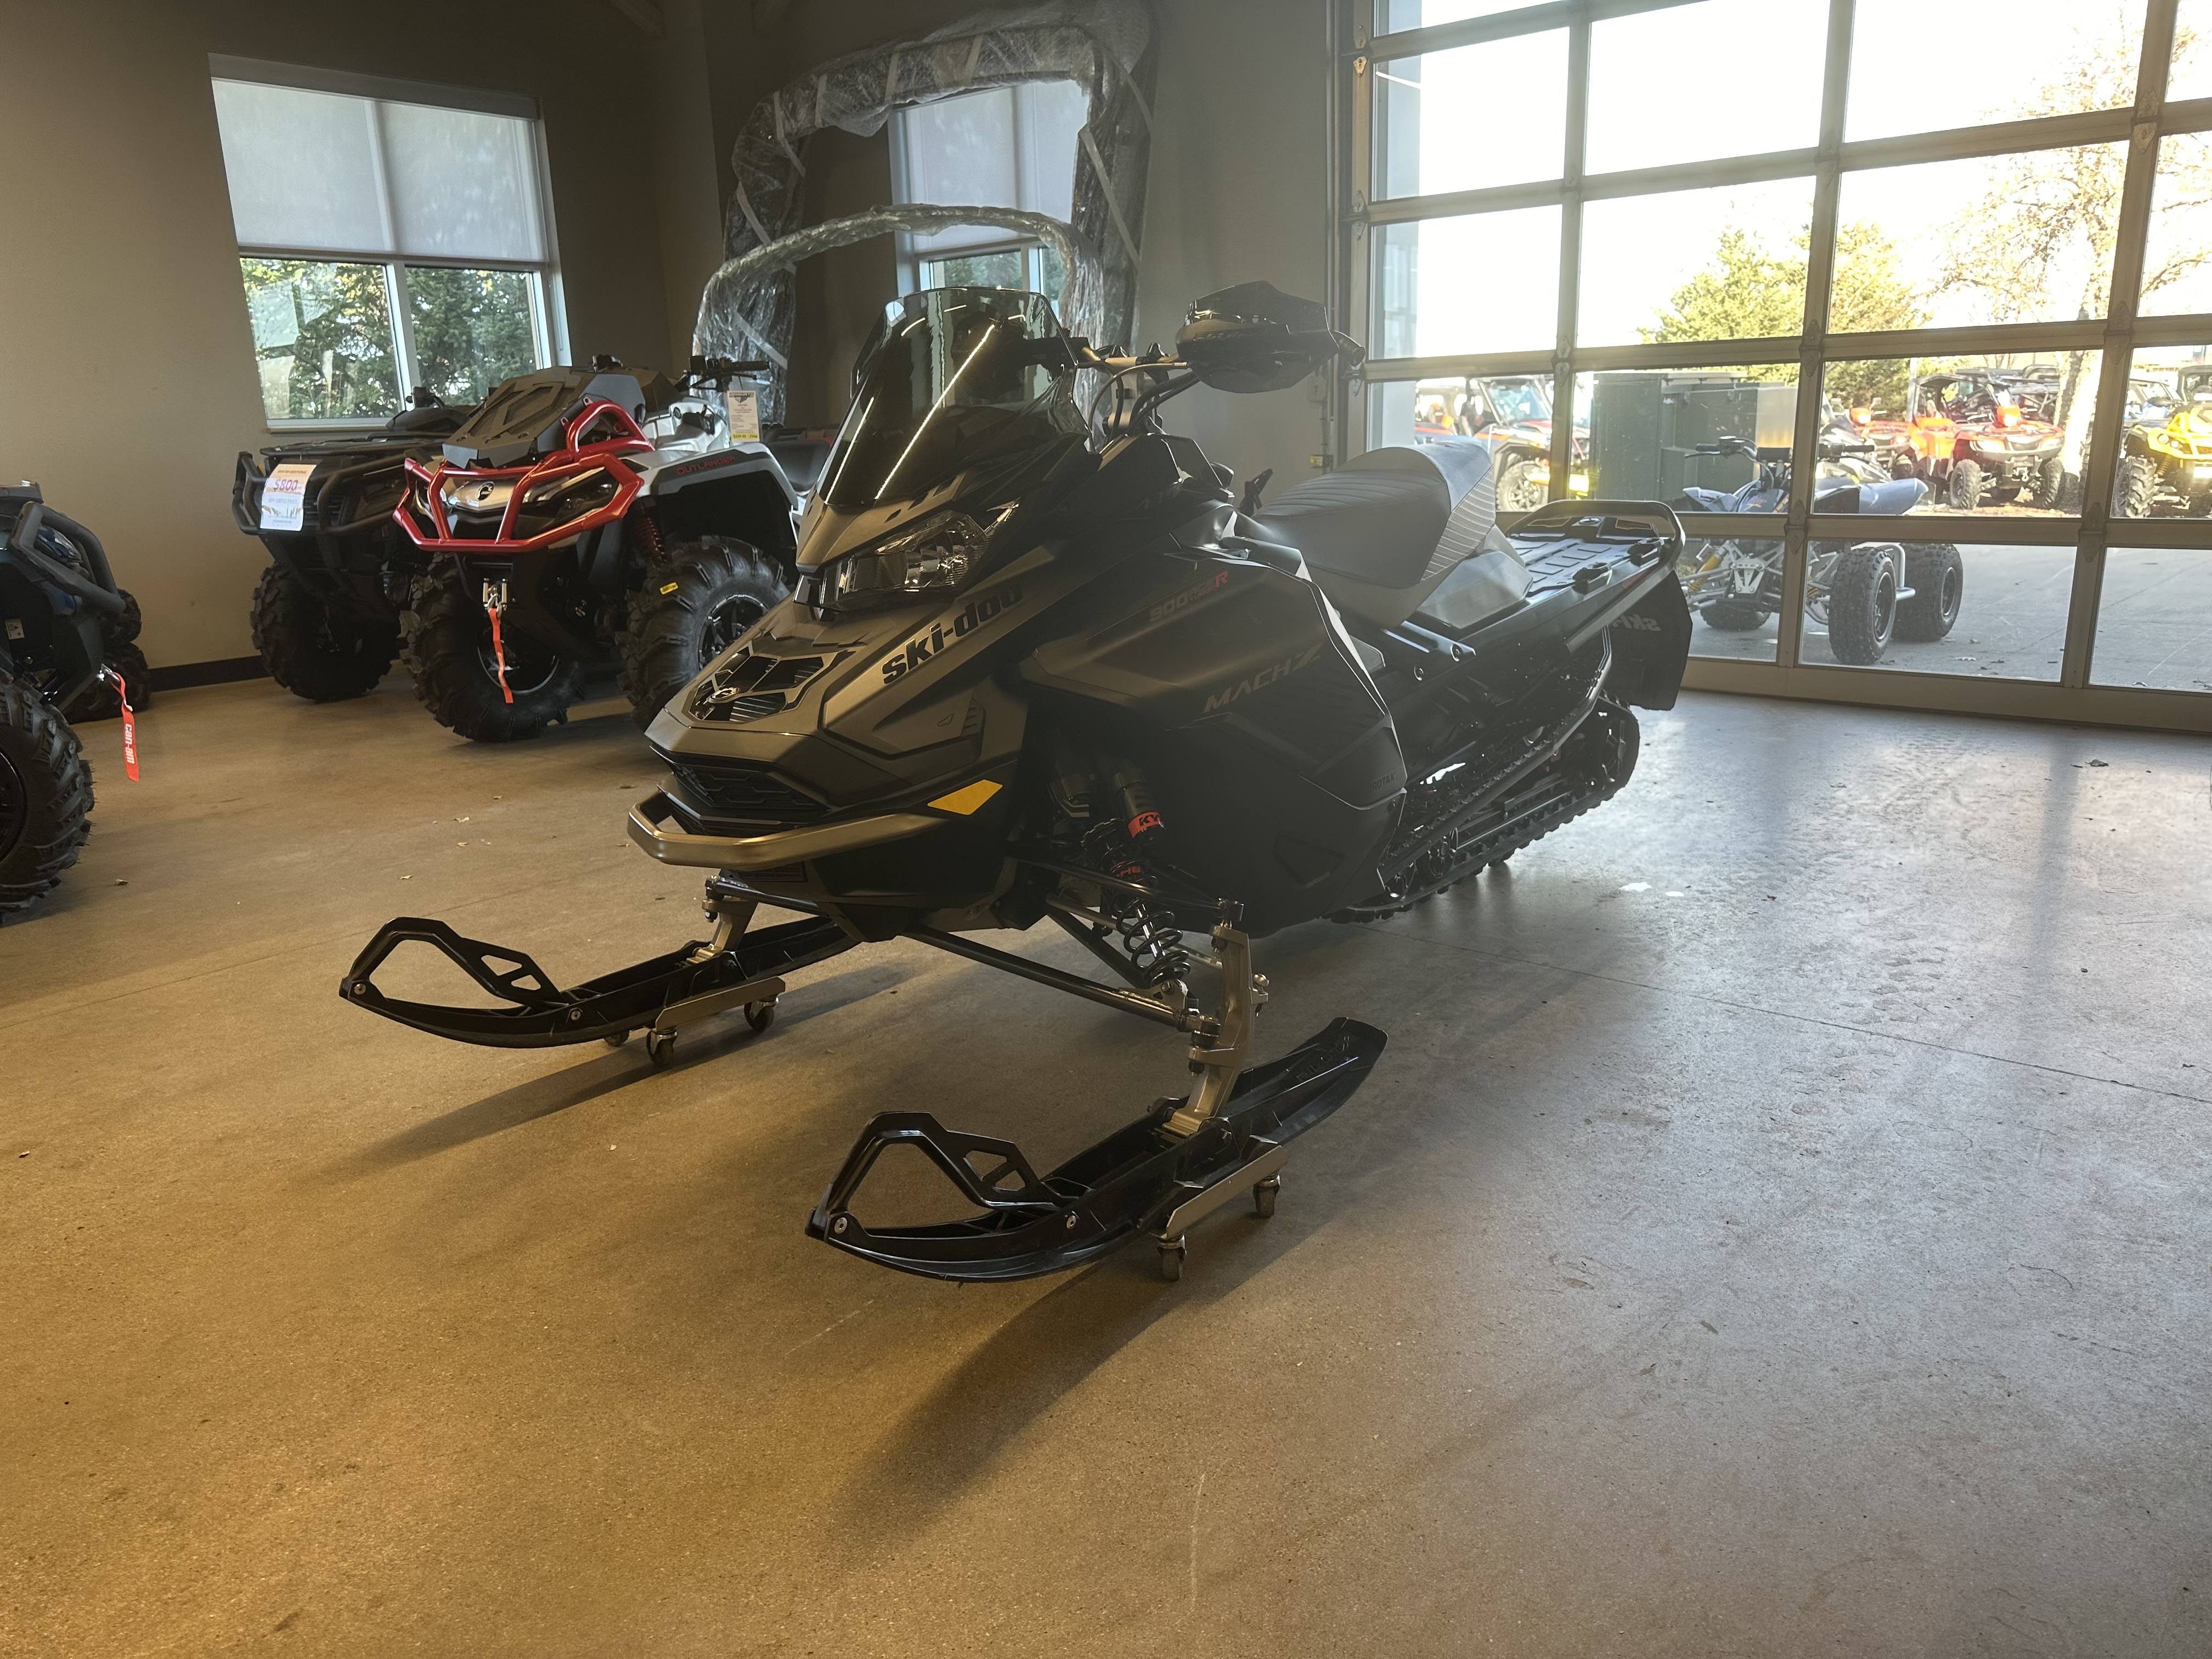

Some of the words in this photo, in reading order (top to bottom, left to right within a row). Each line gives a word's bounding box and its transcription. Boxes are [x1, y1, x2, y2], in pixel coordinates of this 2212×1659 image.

[676, 456, 736, 475] OUTLANDER
[273, 479, 299, 492] $800
[1150, 592, 1189, 624] 900
[1204, 658, 1292, 713] MACH
[125, 723, 136, 764] can-am
[1372, 772, 1395, 792] ROTAX
[1139, 814, 1160, 827] KY
